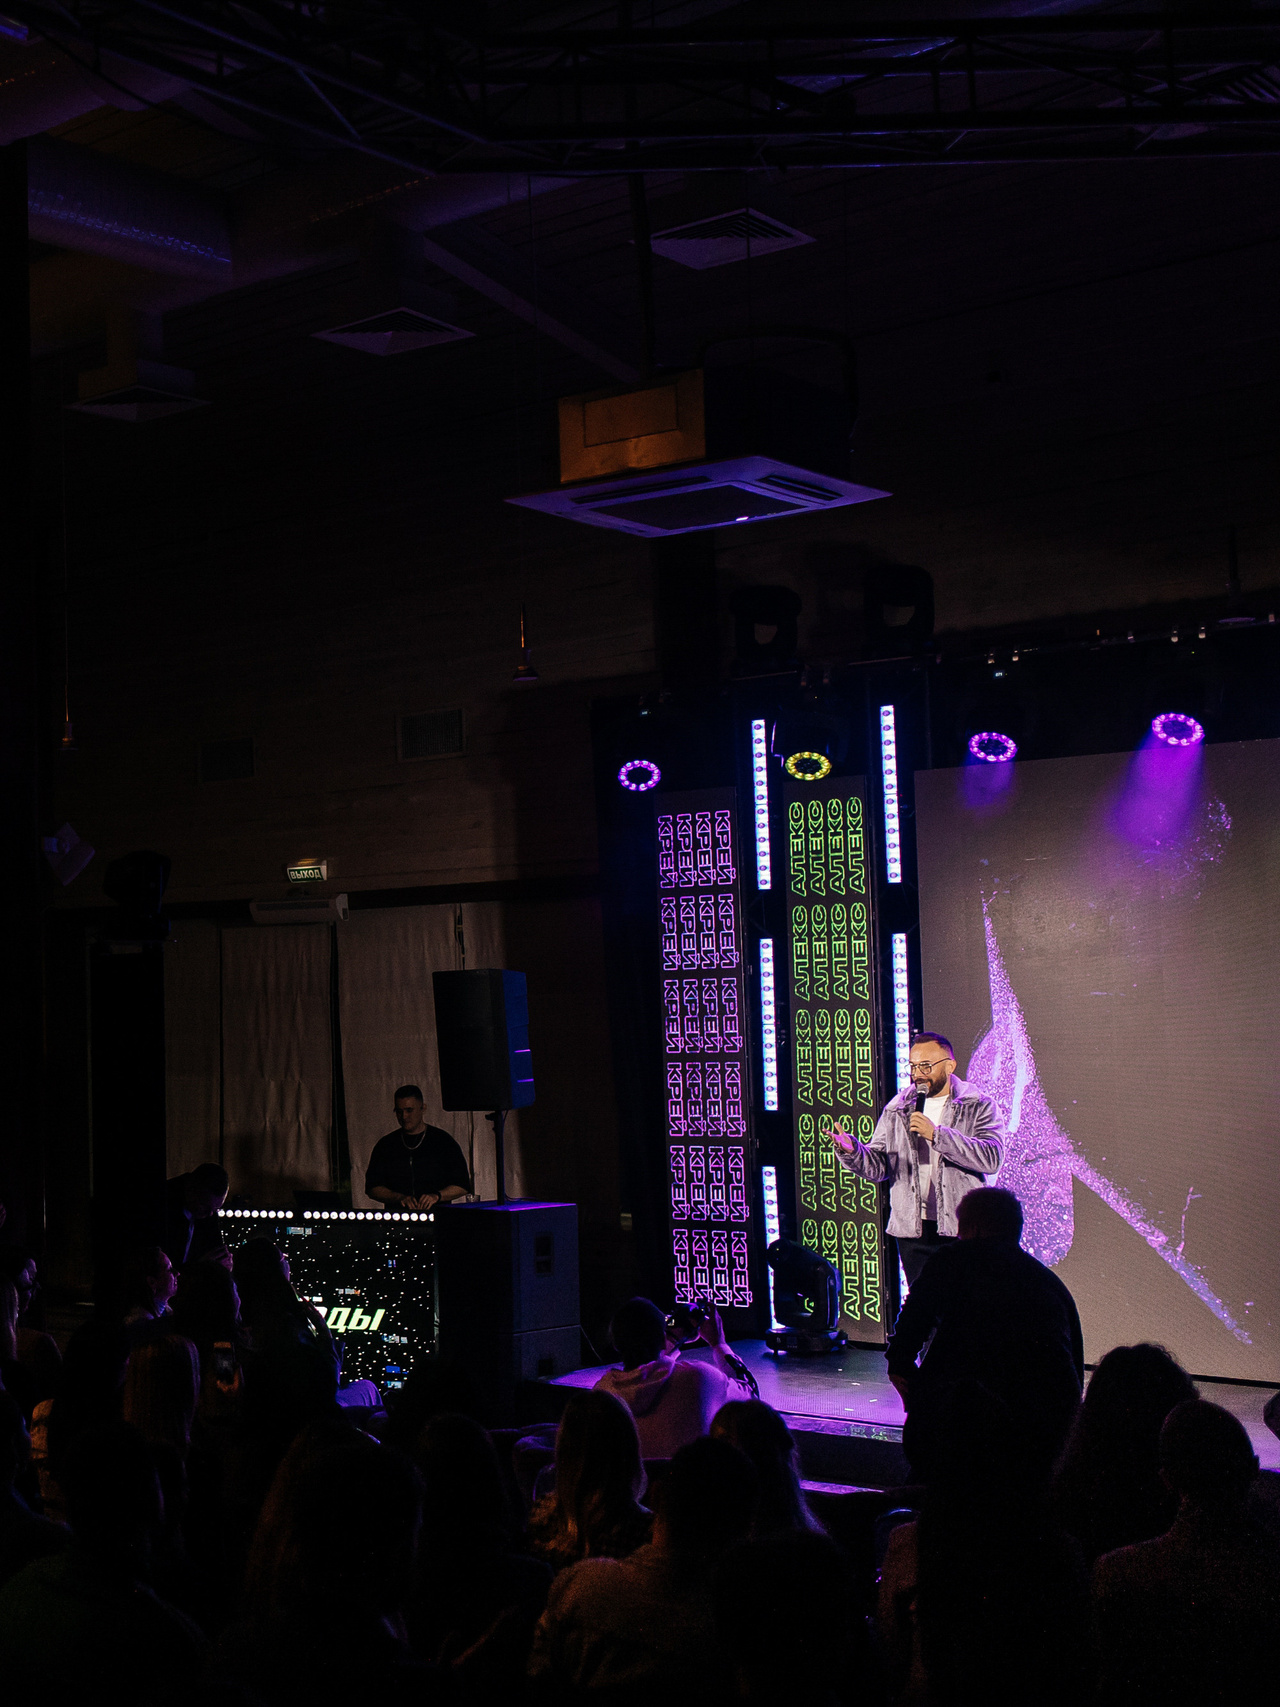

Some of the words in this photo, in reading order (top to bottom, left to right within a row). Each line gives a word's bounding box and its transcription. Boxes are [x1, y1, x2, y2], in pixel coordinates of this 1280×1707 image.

[290, 869, 322, 879] ВЫХОД
[658, 815, 678, 888] КРЕЙ
[676, 813, 698, 887] КРЕЙ
[695, 811, 717, 886] КРЕЙ
[715, 810, 736, 885] КРЕЙ
[789, 802, 807, 897] АЛЕКС
[807, 800, 826, 896] АЛЕКС
[827, 798, 846, 895] АЛЕКС
[846, 797, 865, 894] АЛЕКС
[661, 897, 681, 971] КРЕЙ
[680, 896, 701, 970] КРЕЙ
[699, 895, 720, 969] КРЕЙ
[718, 893, 740, 968] КРЕЙ
[792, 905, 810, 1001] АЛЕКС
[811, 904, 829, 1001] АЛЕКС
[830, 903, 849, 1001] АЛЕКС
[850, 902, 869, 1000] АЛЕКС
[664, 979, 685, 1054] КРЕЙ
[683, 979, 704, 1053] КРЕЙ
[702, 978, 723, 1053] КРЕЙ
[721, 977, 743, 1053] КРЕЙ
[795, 1009, 813, 1106] АЛЕКС
[815, 1009, 833, 1106] АЛЕКС
[834, 1009, 853, 1107] АЛЕКС
[854, 1008, 873, 1107] АЛЕКС
[667, 1062, 688, 1137] КРЕЙ
[686, 1062, 707, 1137] КРЕЙ
[705, 1062, 727, 1137] КРЕЙ
[725, 1061, 747, 1137] КРЕЙ
[670, 1145, 691, 1220] КРЕЙ
[689, 1145, 710, 1221] КРЕЙ
[708, 1146, 730, 1221] КРЕЙ
[728, 1146, 750, 1222] КРЕЙ
[798, 1113, 817, 1211] АЛЕКС
[673, 1229, 694, 1304] КРЕЙ
[711, 1230, 733, 1307] КРЕЙ
[731, 1231, 753, 1308] КРЕЙ
[841, 1221, 861, 1321] АЛЕКС
[861, 1222, 881, 1323] АЛЕКС
